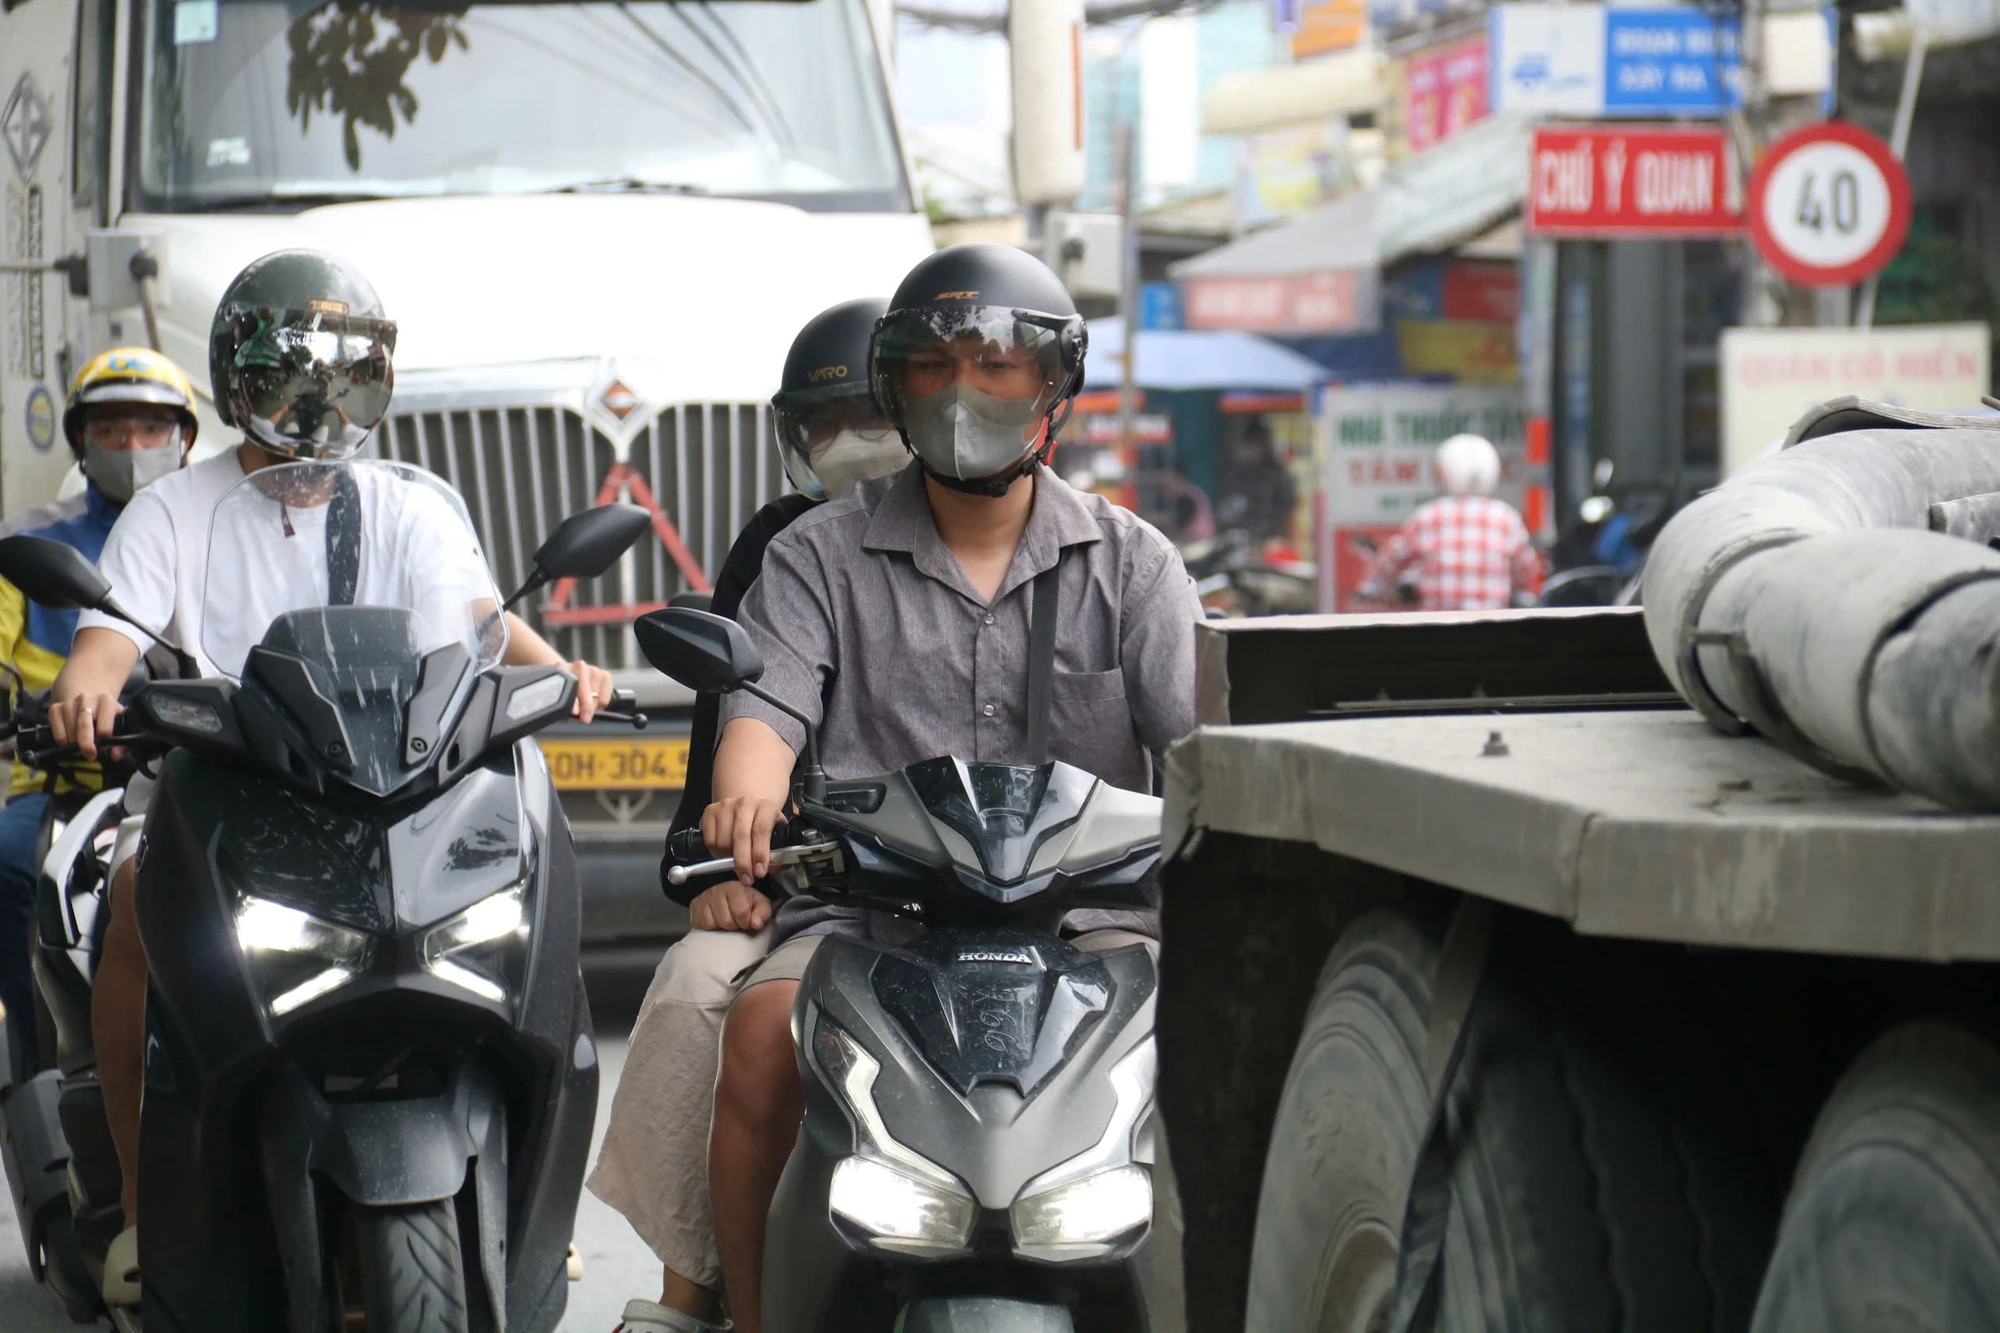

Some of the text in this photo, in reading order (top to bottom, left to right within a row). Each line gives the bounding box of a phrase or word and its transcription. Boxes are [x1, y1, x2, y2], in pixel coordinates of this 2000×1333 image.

[1537, 137, 1594, 214] CHÚ
[1603, 137, 1627, 214] Ý
[1634, 151, 1715, 215] QUAN
[1795, 169, 1858, 234] 40
[957, 952, 1032, 965] HONDA
